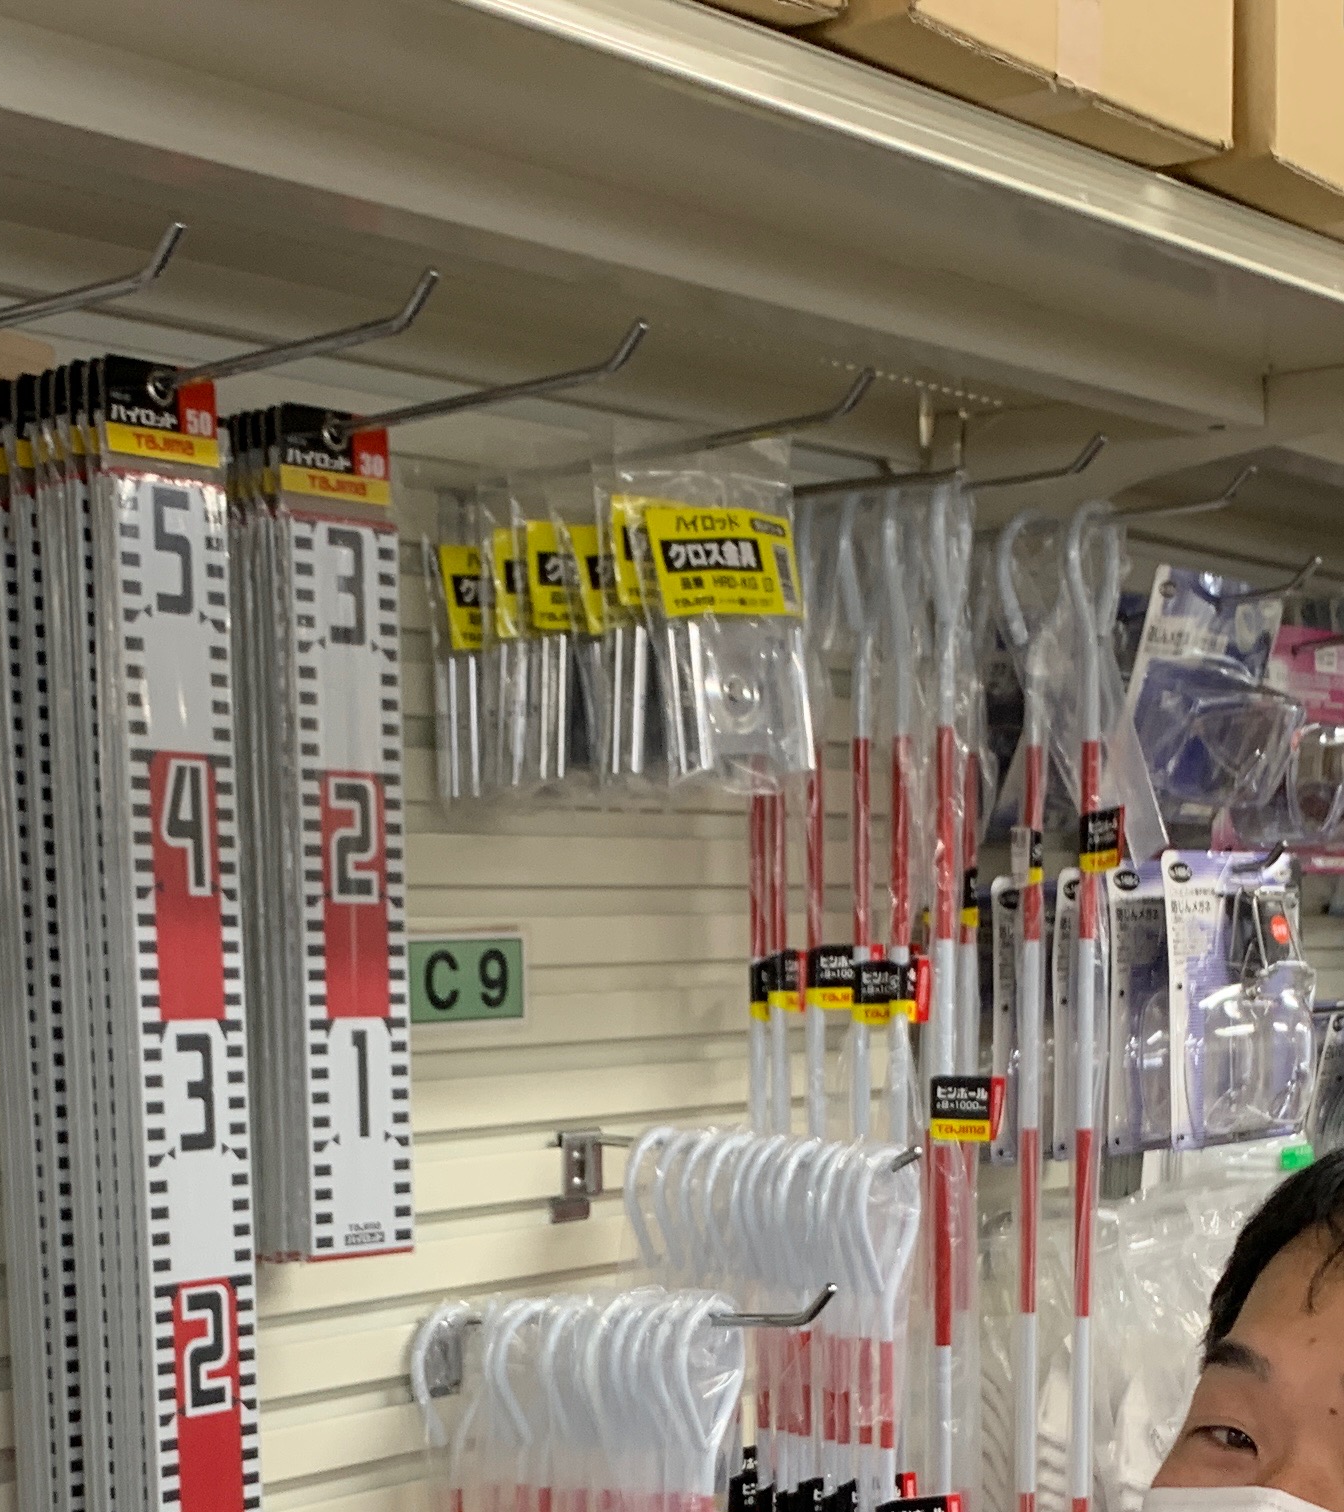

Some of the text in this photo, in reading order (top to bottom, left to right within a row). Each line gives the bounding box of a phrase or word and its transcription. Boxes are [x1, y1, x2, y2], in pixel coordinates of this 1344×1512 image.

[185, 408, 212, 437] 50
[359, 454, 386, 478] 30
[154, 486, 194, 615] 5
[328, 526, 366, 647] 3
[161, 759, 214, 896] 4
[329, 777, 380, 904] 2
[425, 949, 508, 1011] C 9
[175, 1033, 216, 1152] 3
[351, 1029, 370, 1138] 1
[180, 1283, 233, 1418] 2
